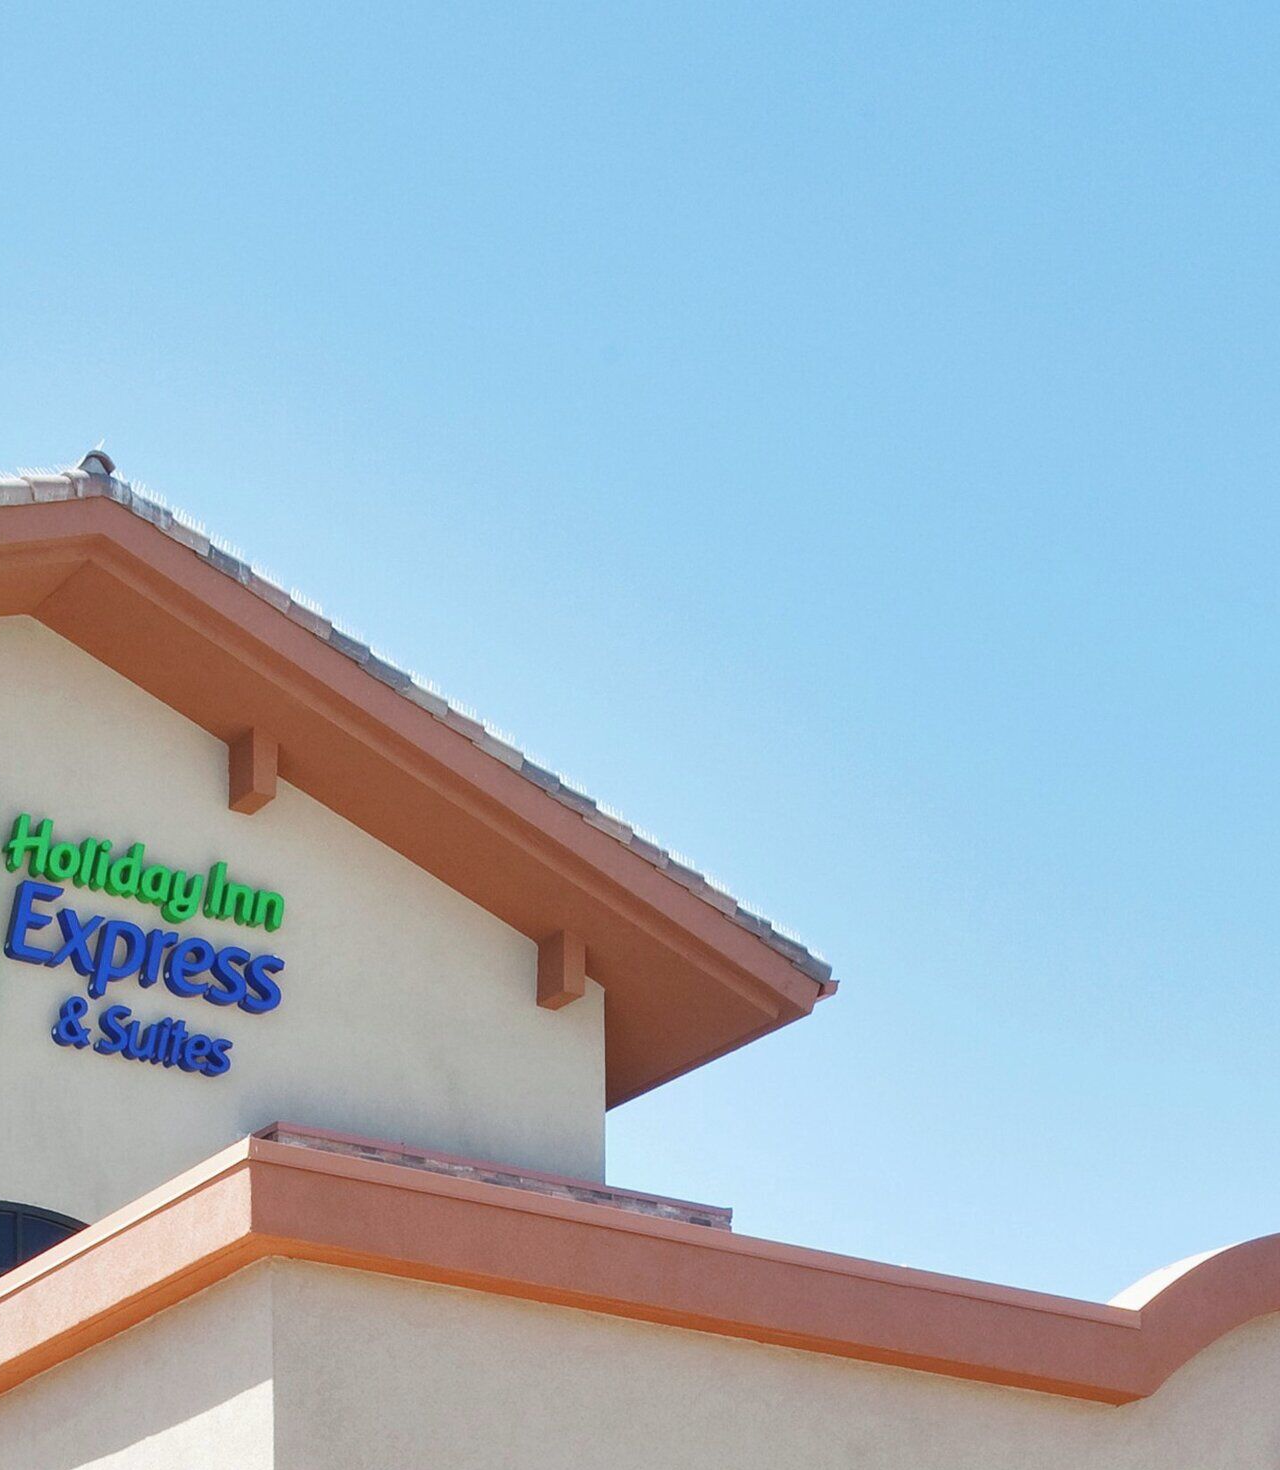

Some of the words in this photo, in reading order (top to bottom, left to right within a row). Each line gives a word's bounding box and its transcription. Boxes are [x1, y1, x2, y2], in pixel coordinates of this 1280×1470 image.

[5, 812, 203, 924] Holiday
[204, 861, 285, 932] Inn
[4, 880, 285, 1014] Express
[51, 996, 91, 1049] &
[93, 1005, 233, 1077] Suites
